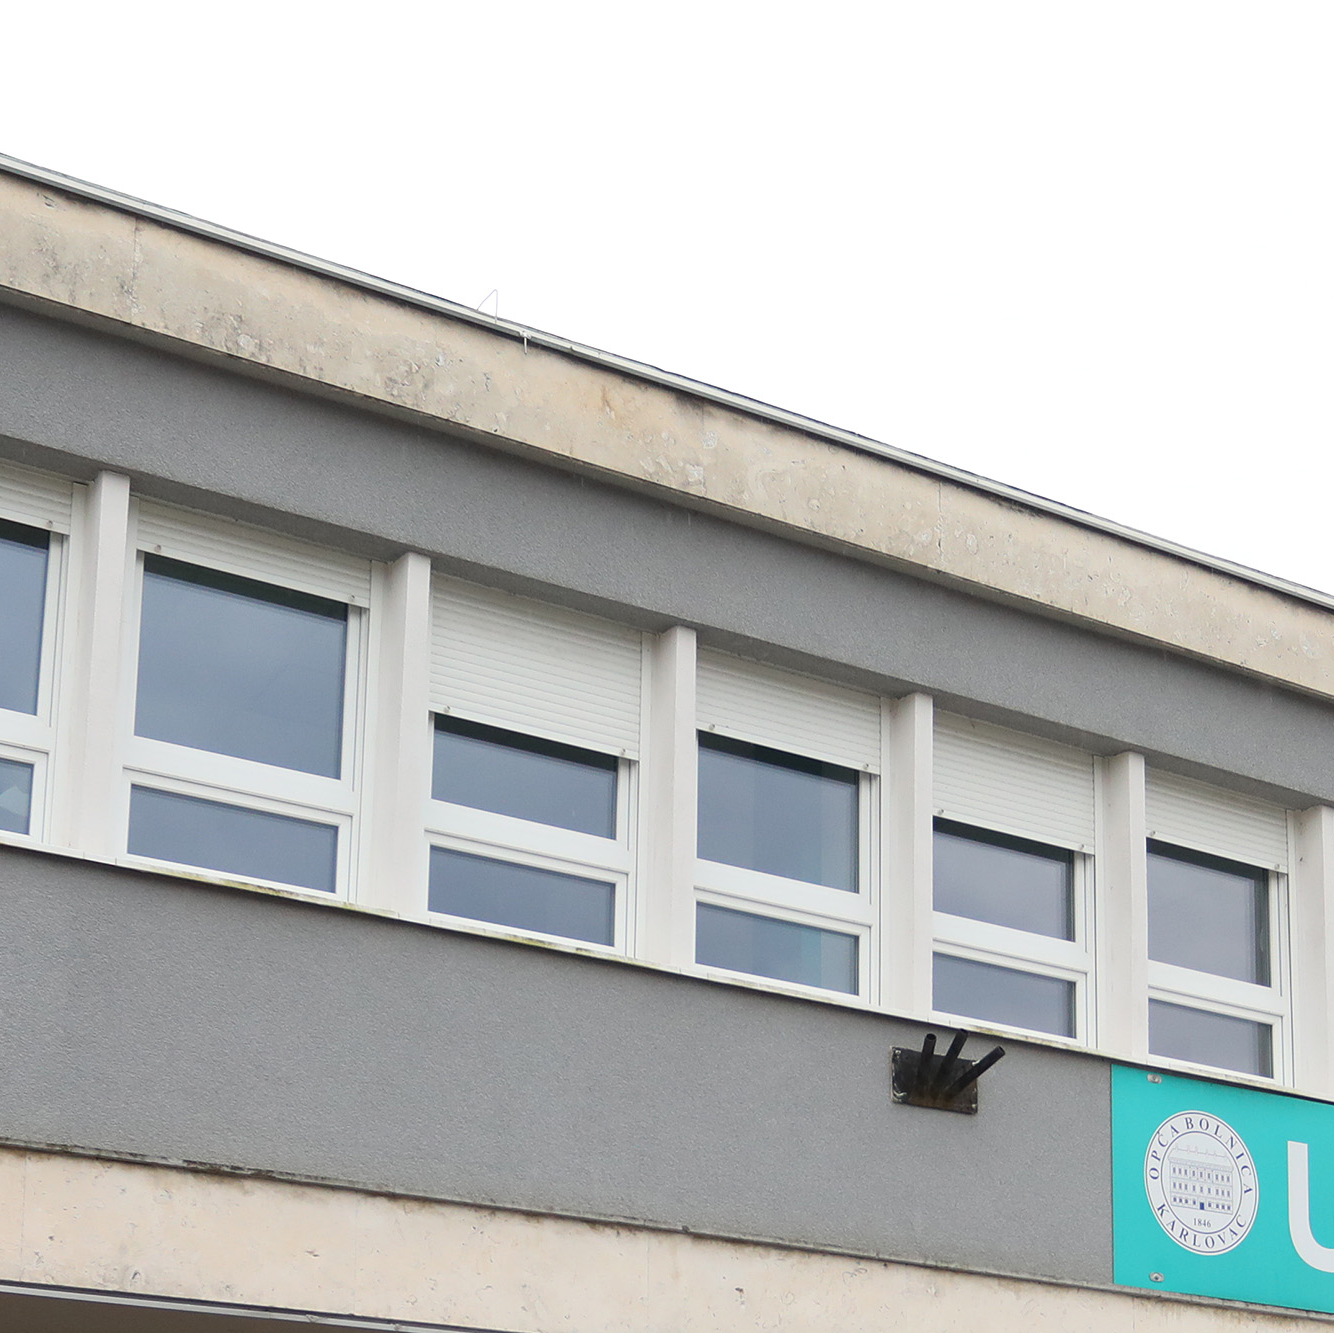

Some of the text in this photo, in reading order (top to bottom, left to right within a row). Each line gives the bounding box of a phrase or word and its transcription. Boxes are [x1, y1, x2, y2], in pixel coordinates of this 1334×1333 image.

[1184, 1116, 1253, 1194] BOLNICA
[1157, 1203, 1247, 1249] KARLOVAC
[1193, 1217, 1212, 1228] 1846
